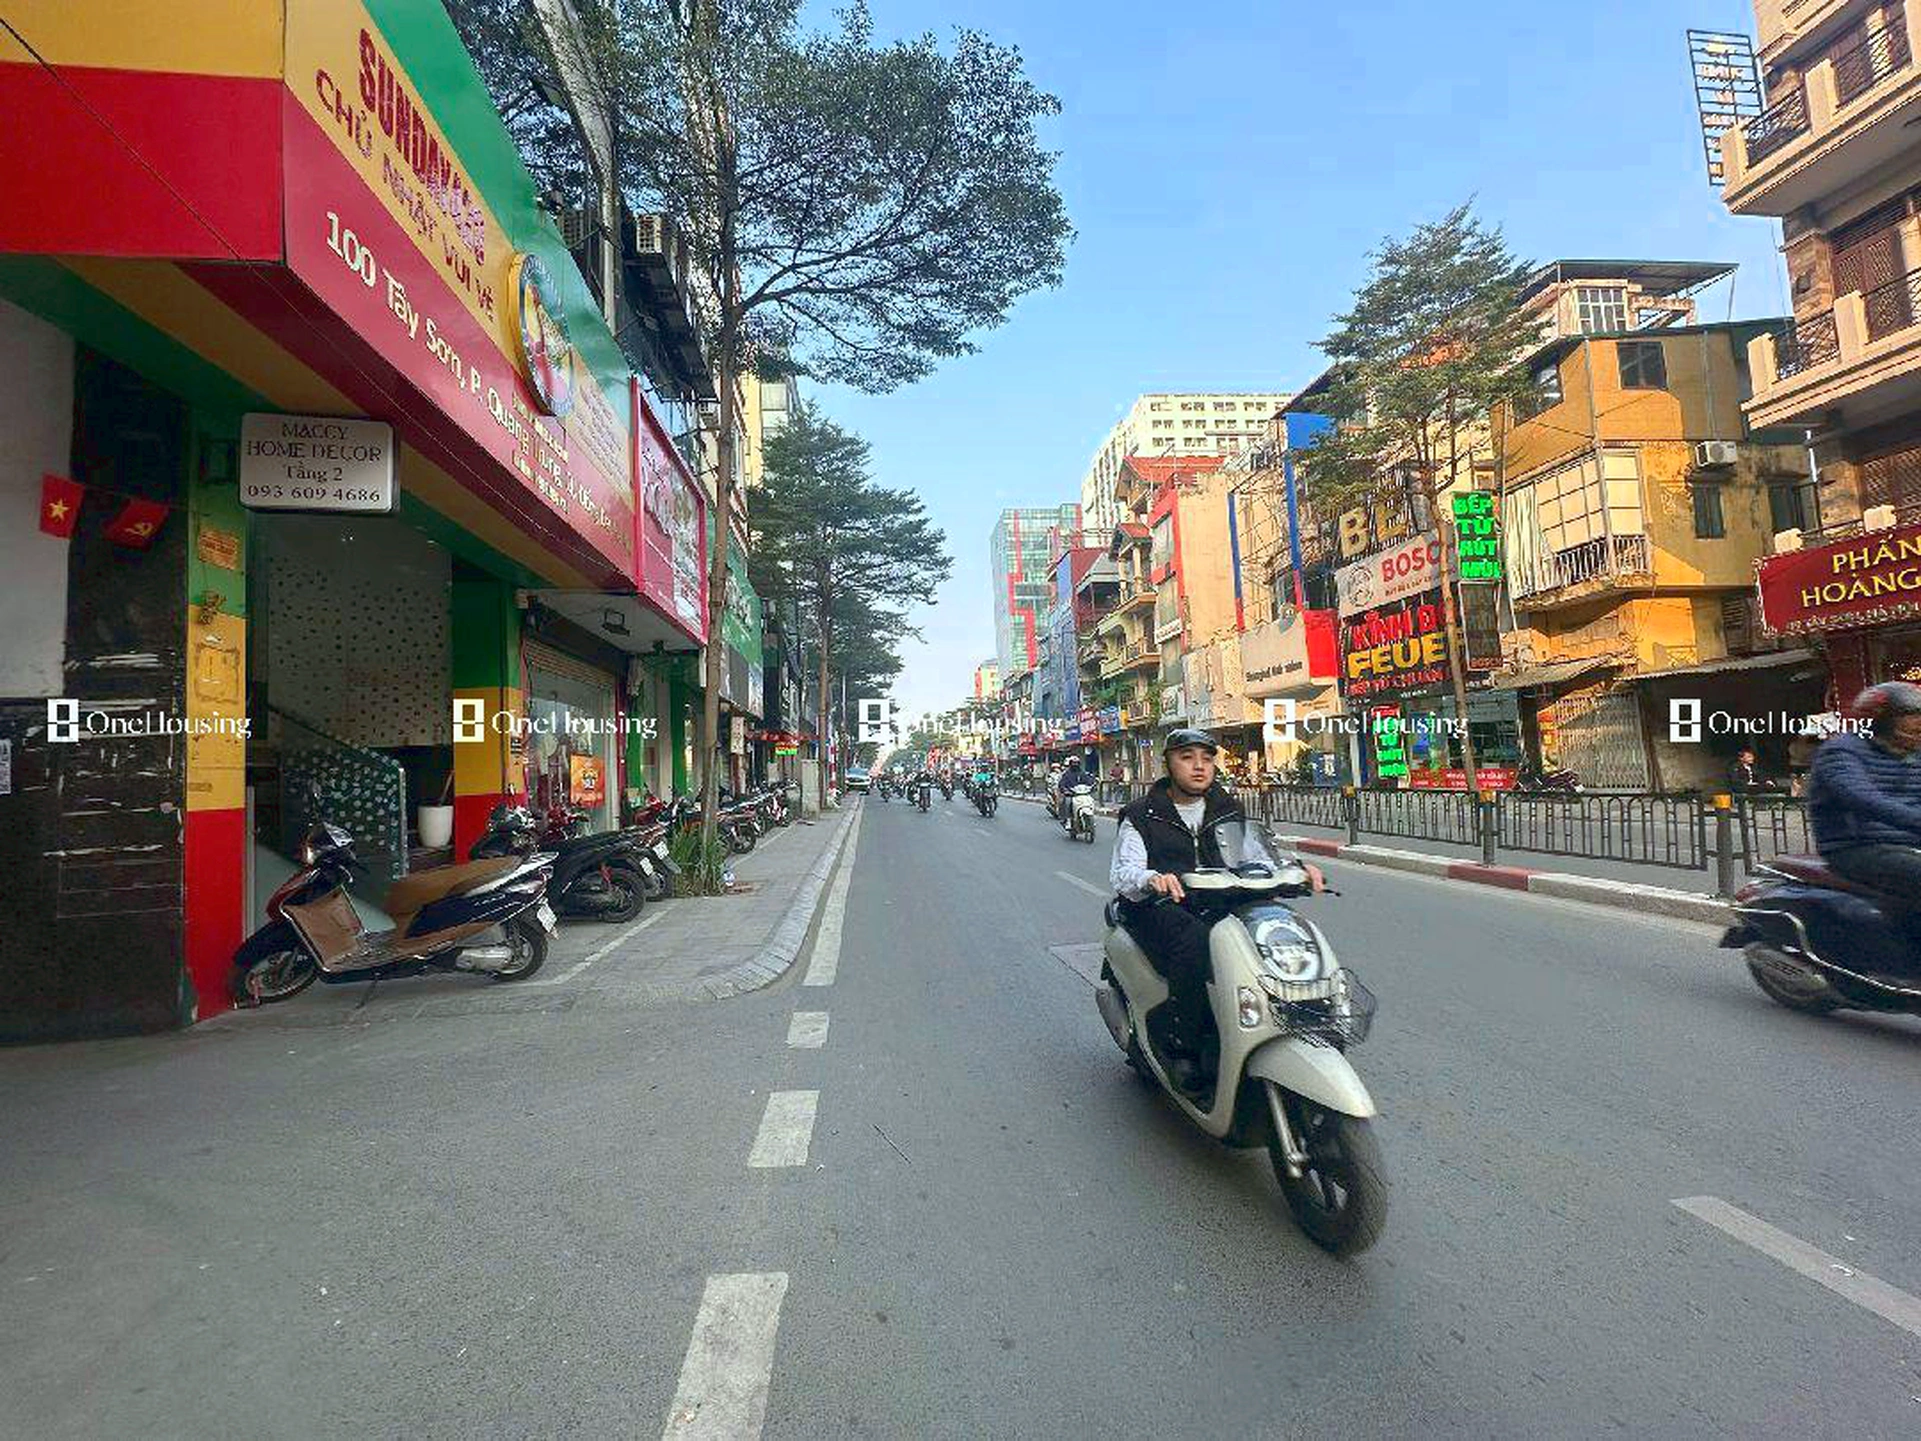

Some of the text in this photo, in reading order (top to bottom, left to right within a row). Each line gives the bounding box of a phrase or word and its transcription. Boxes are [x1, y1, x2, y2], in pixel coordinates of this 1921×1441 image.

[326, 211, 377, 287] 100
[382, 267, 419, 341] Tây
[426, 317, 466, 389] Sơn,
[248, 440, 382, 462] HOME DECOR
[285, 460, 343, 483] Tầng 2
[248, 484, 380, 503] 093 609 4686
[1453, 493, 1493, 515] BẾP
[1455, 515, 1495, 535] TỪ
[1460, 536, 1497, 556] RÚT
[1832, 533, 1921, 574] PHẤN
[1381, 540, 1457, 582] BOSC
